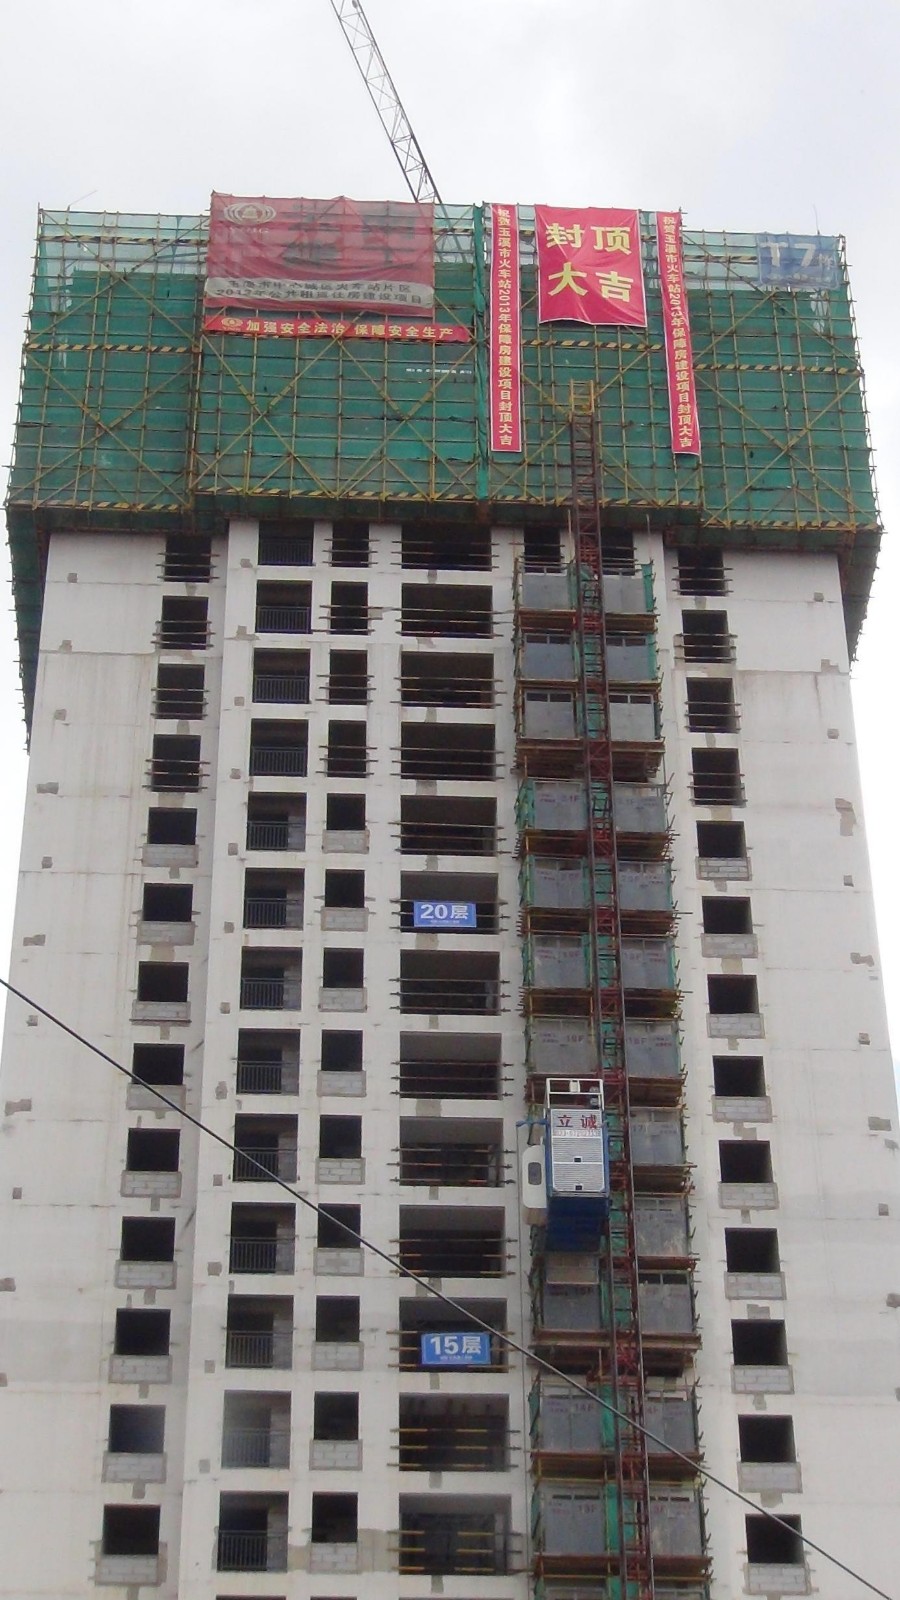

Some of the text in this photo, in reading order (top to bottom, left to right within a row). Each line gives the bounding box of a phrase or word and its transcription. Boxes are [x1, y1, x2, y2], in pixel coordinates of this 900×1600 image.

[546, 222, 632, 255] 封顶
[548, 261, 634, 303] 大吉
[246, 319, 454, 339] 加强安全法治 保障安全生产
[420, 904, 469, 920] 20层
[556, 1114, 597, 1129] 立诚
[430, 1336, 481, 1355] 15层
